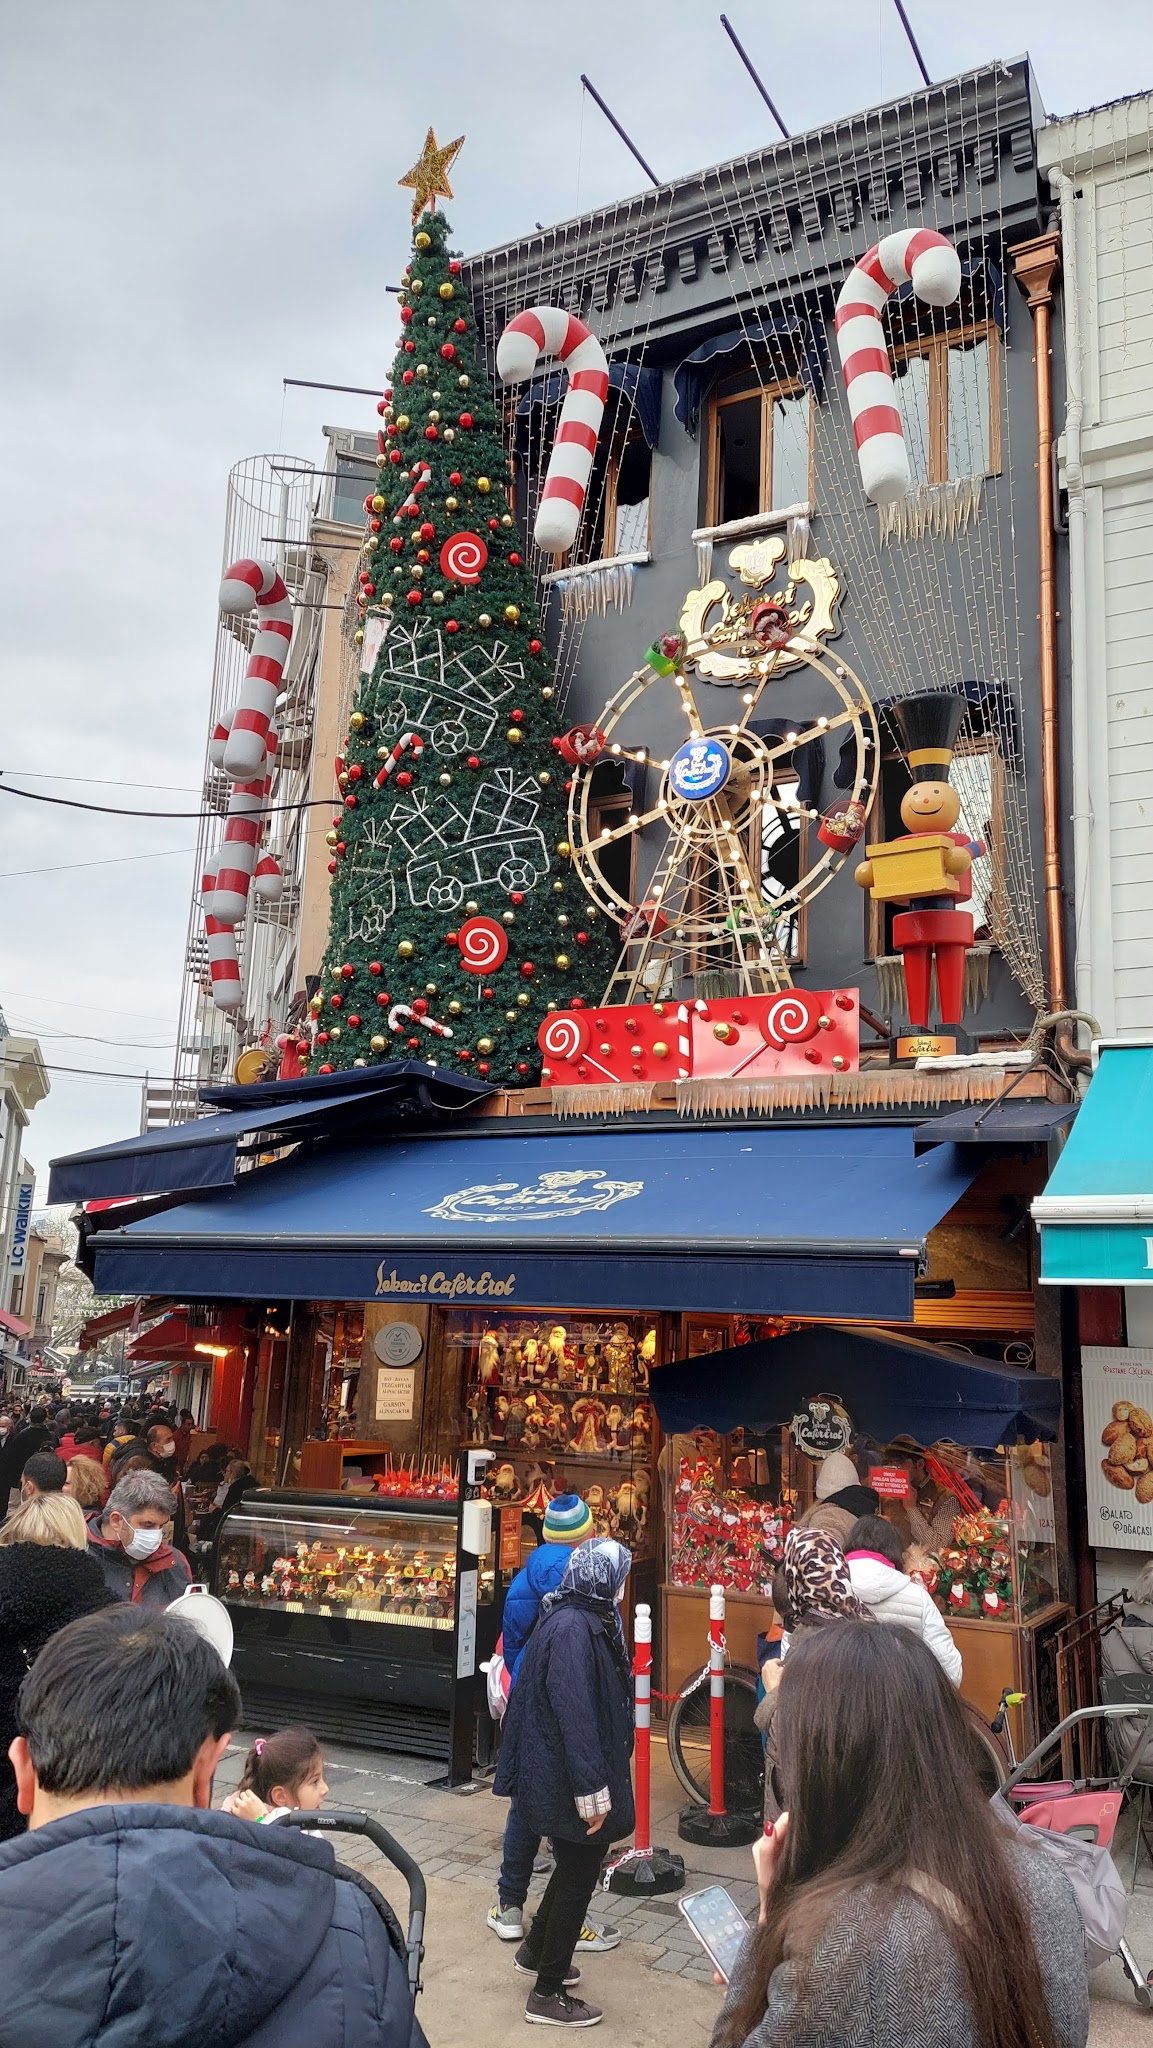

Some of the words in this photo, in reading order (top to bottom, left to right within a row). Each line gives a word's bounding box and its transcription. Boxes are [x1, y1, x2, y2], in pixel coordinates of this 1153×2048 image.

[10, 1246, 24, 1267] LC
[1100, 1505, 1133, 1520] BALAT
[1113, 1520, 1152, 1536] POĞAÇASI
